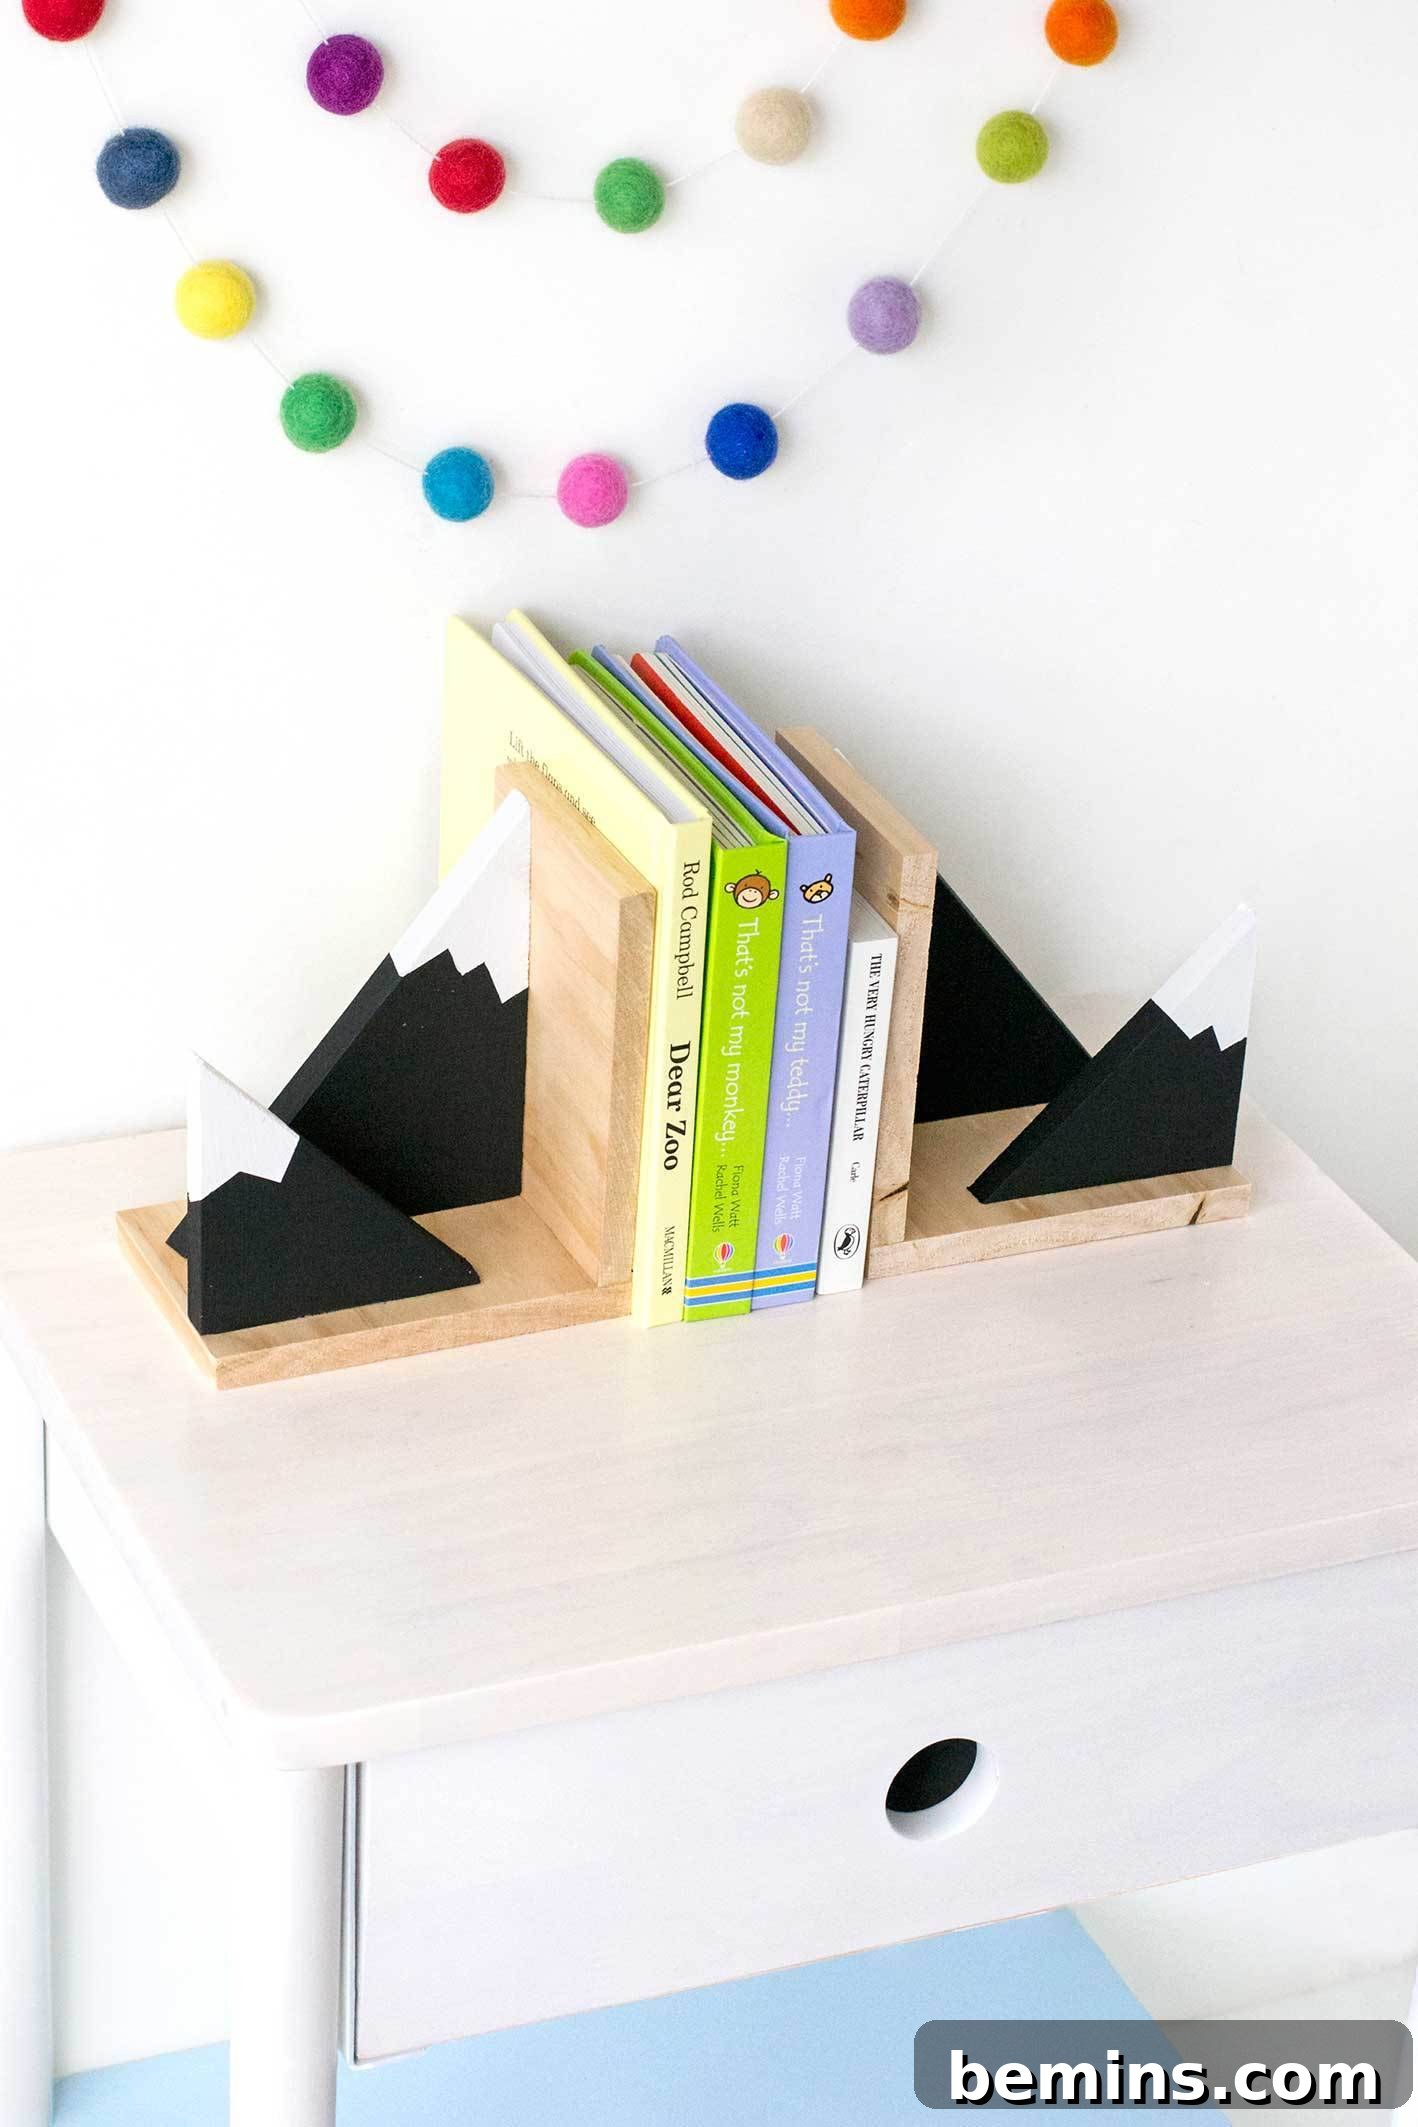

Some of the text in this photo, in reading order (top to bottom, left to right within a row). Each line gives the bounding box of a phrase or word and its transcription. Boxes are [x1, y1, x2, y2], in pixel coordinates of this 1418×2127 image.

[526, 748, 540, 769] the
[674, 860, 700, 1000] Rod Campbell
[715, 916, 760, 1158] That's not my monkey...
[780, 914, 824, 1127] That's not my teddy...
[852, 953, 882, 1141] THE VERY HUNGRY CATERPILLAR
[663, 1040, 691, 1170] Dear Zoo
[712, 1165, 728, 1232] Rachel Wells
[728, 1165, 744, 1228] Fiona Watt
[774, 1155, 790, 1225] Rachel Wells
[790, 1156, 806, 1220] Fiona Watt
[849, 1161, 860, 1183] Carle
[661, 1226, 675, 1288] MACMILLAN
